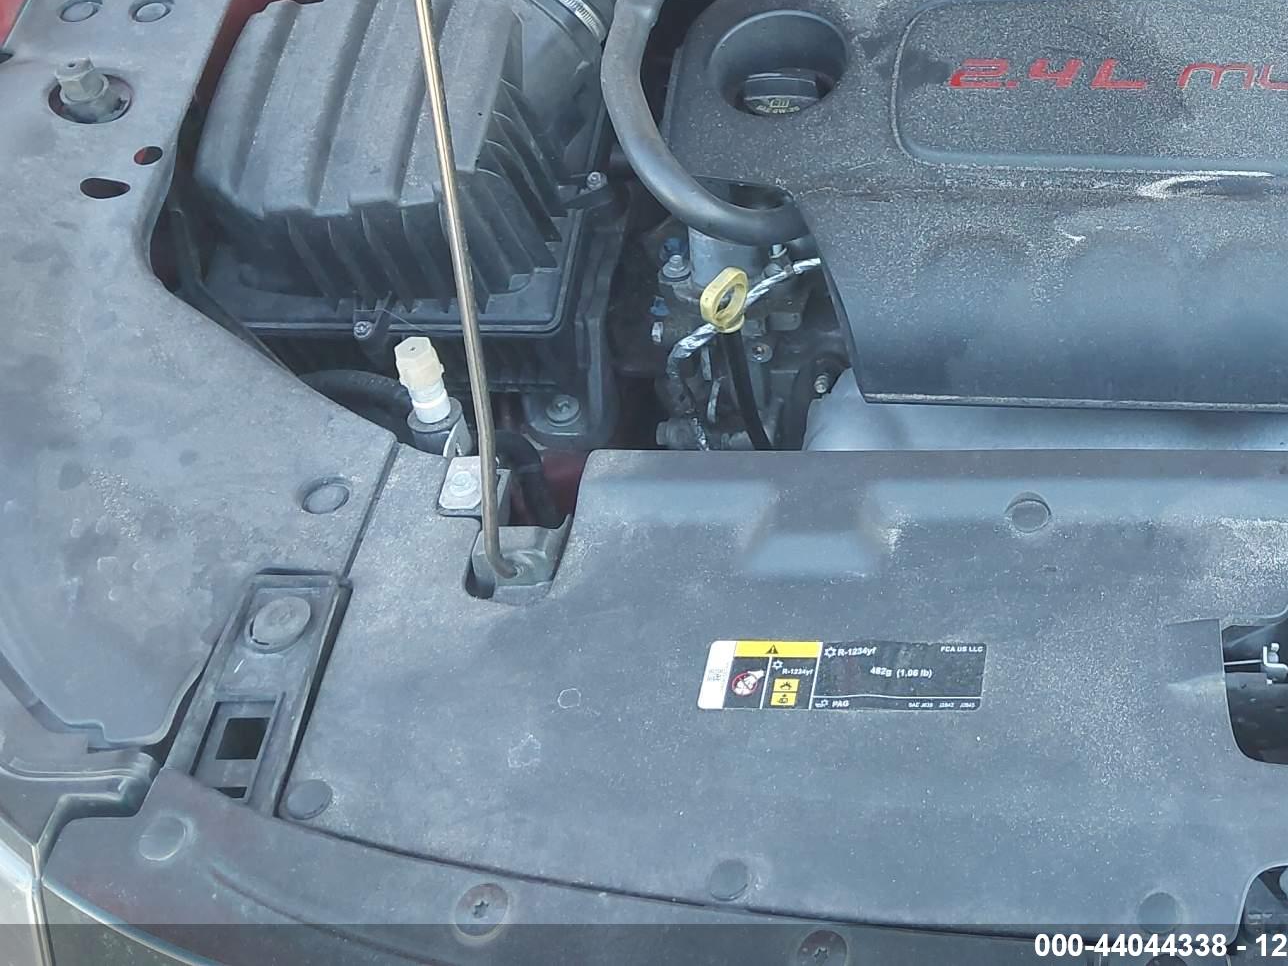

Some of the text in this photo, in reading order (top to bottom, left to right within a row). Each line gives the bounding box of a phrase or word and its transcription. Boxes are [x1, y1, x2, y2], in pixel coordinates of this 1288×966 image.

[948, 58, 1146, 91] 2.4L
[837, 646, 877, 657] R-1234yf
[782, 667, 814, 676] R-1234yf
[920, 668, 933, 679] lb)
[832, 700, 850, 708] PAG
